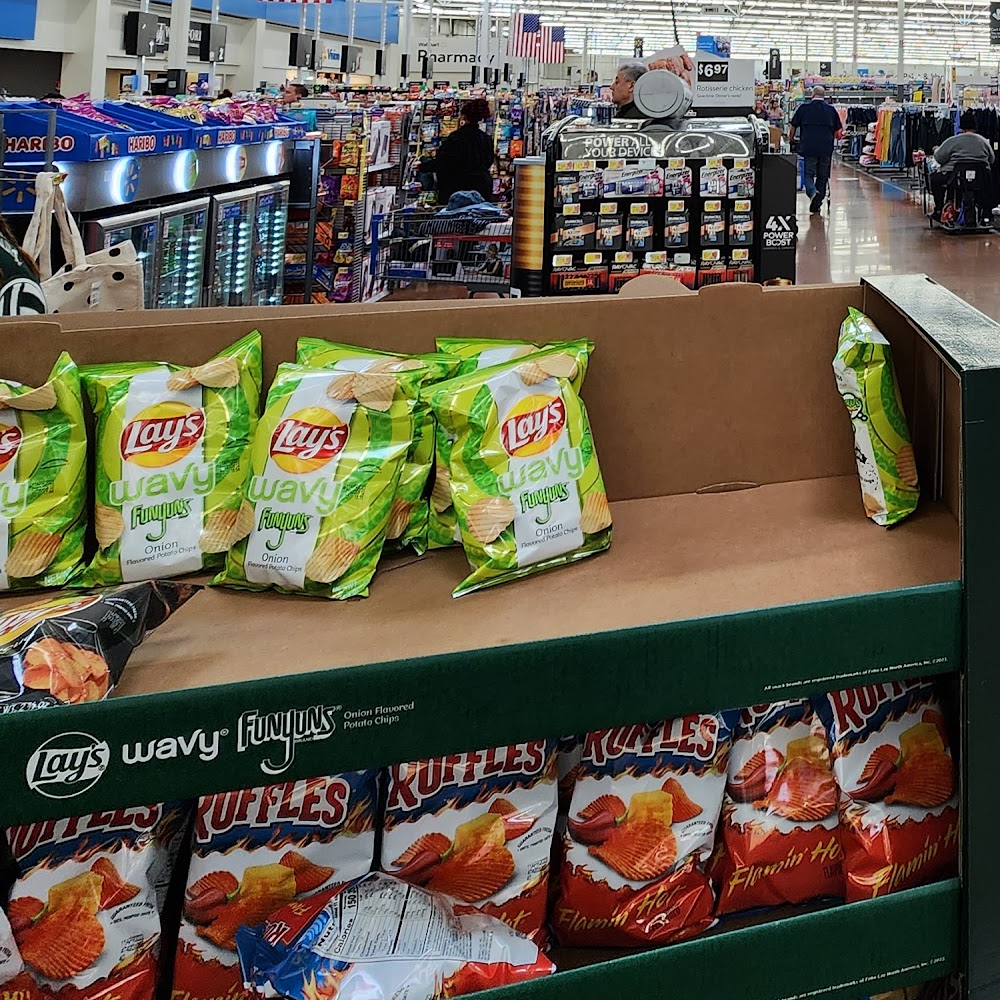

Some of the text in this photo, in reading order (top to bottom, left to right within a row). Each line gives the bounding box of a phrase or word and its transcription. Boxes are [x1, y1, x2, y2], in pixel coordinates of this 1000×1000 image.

[729, 84, 754, 92] chicken
[128, 136, 156, 152] HARIBO
[217, 129, 237, 144] HARIBO
[584, 136, 629, 147] POWER
[584, 147, 617, 158] YOUR
[621, 169, 645, 178] Energizer
[666, 169, 691, 180] Energizer
[701, 168, 725, 179] Energizer
[729, 171, 754, 181] Energizer
[765, 216, 791, 231] 4X
[763, 232, 794, 240] POWER
[765, 239, 792, 247] BOOST
[504, 399, 562, 451] Lay's
[125, 412, 202, 454] Lay's
[272, 416, 347, 460] Lay's
[497, 446, 585, 498] wavy
[110, 462, 216, 506] wavy
[247, 475, 343, 515] wavy
[535, 523, 563, 537] Onion
[145, 541, 178, 554] Onion
[521, 537, 546, 549] Flavored
[546, 532, 563, 542] Potato
[126, 555, 155, 566] Flavored
[157, 550, 178, 560] Potato
[262, 552, 289, 563] Onion
[344, 701, 415, 720] Onion Flavored
[344, 714, 400, 729] Potato Chips
[35, 743, 106, 785] Lay's
[122, 730, 219, 765] wavy
